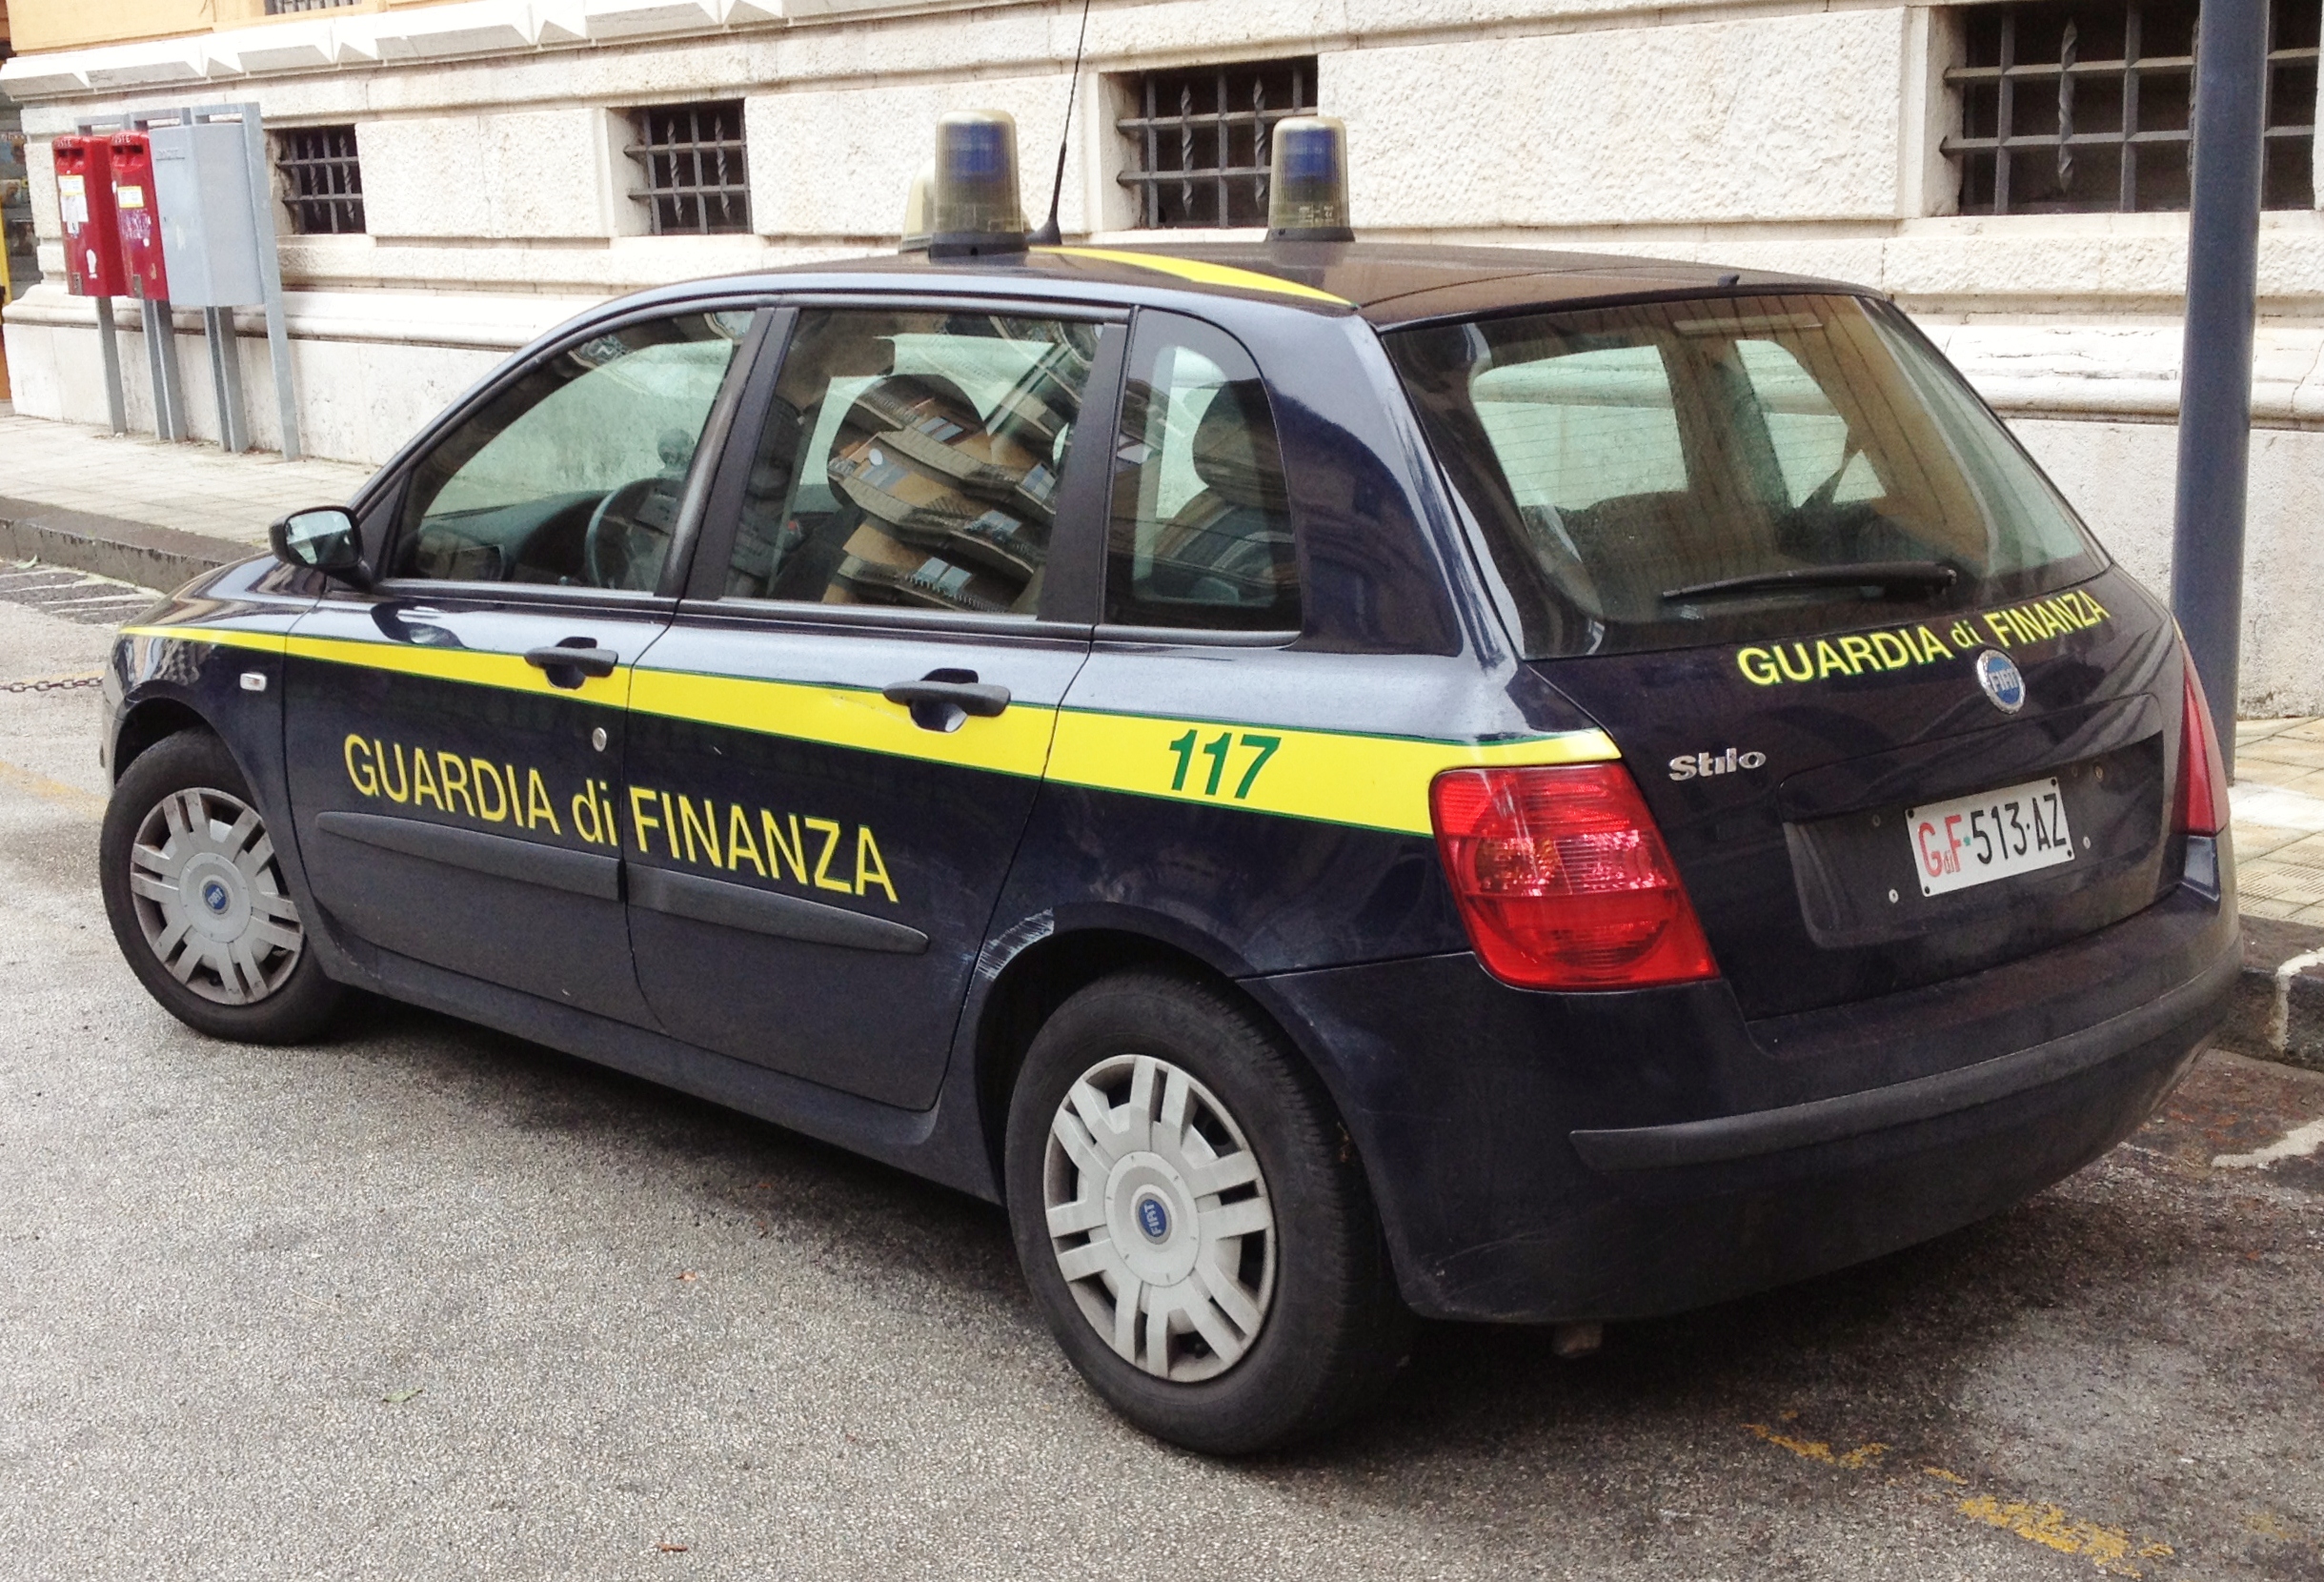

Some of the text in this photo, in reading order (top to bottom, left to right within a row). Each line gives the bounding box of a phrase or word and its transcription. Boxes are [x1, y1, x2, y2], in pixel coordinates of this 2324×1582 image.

[1737, 589, 2110, 685] GUARDIA di FINANZA
[1988, 668, 2020, 693] FIAT
[1168, 728, 1282, 800] 117
[1667, 747, 1767, 781] Stilo
[343, 733, 899, 903] GUARDIA di FINANZA
[1143, 1202, 1162, 1235] FIAT
